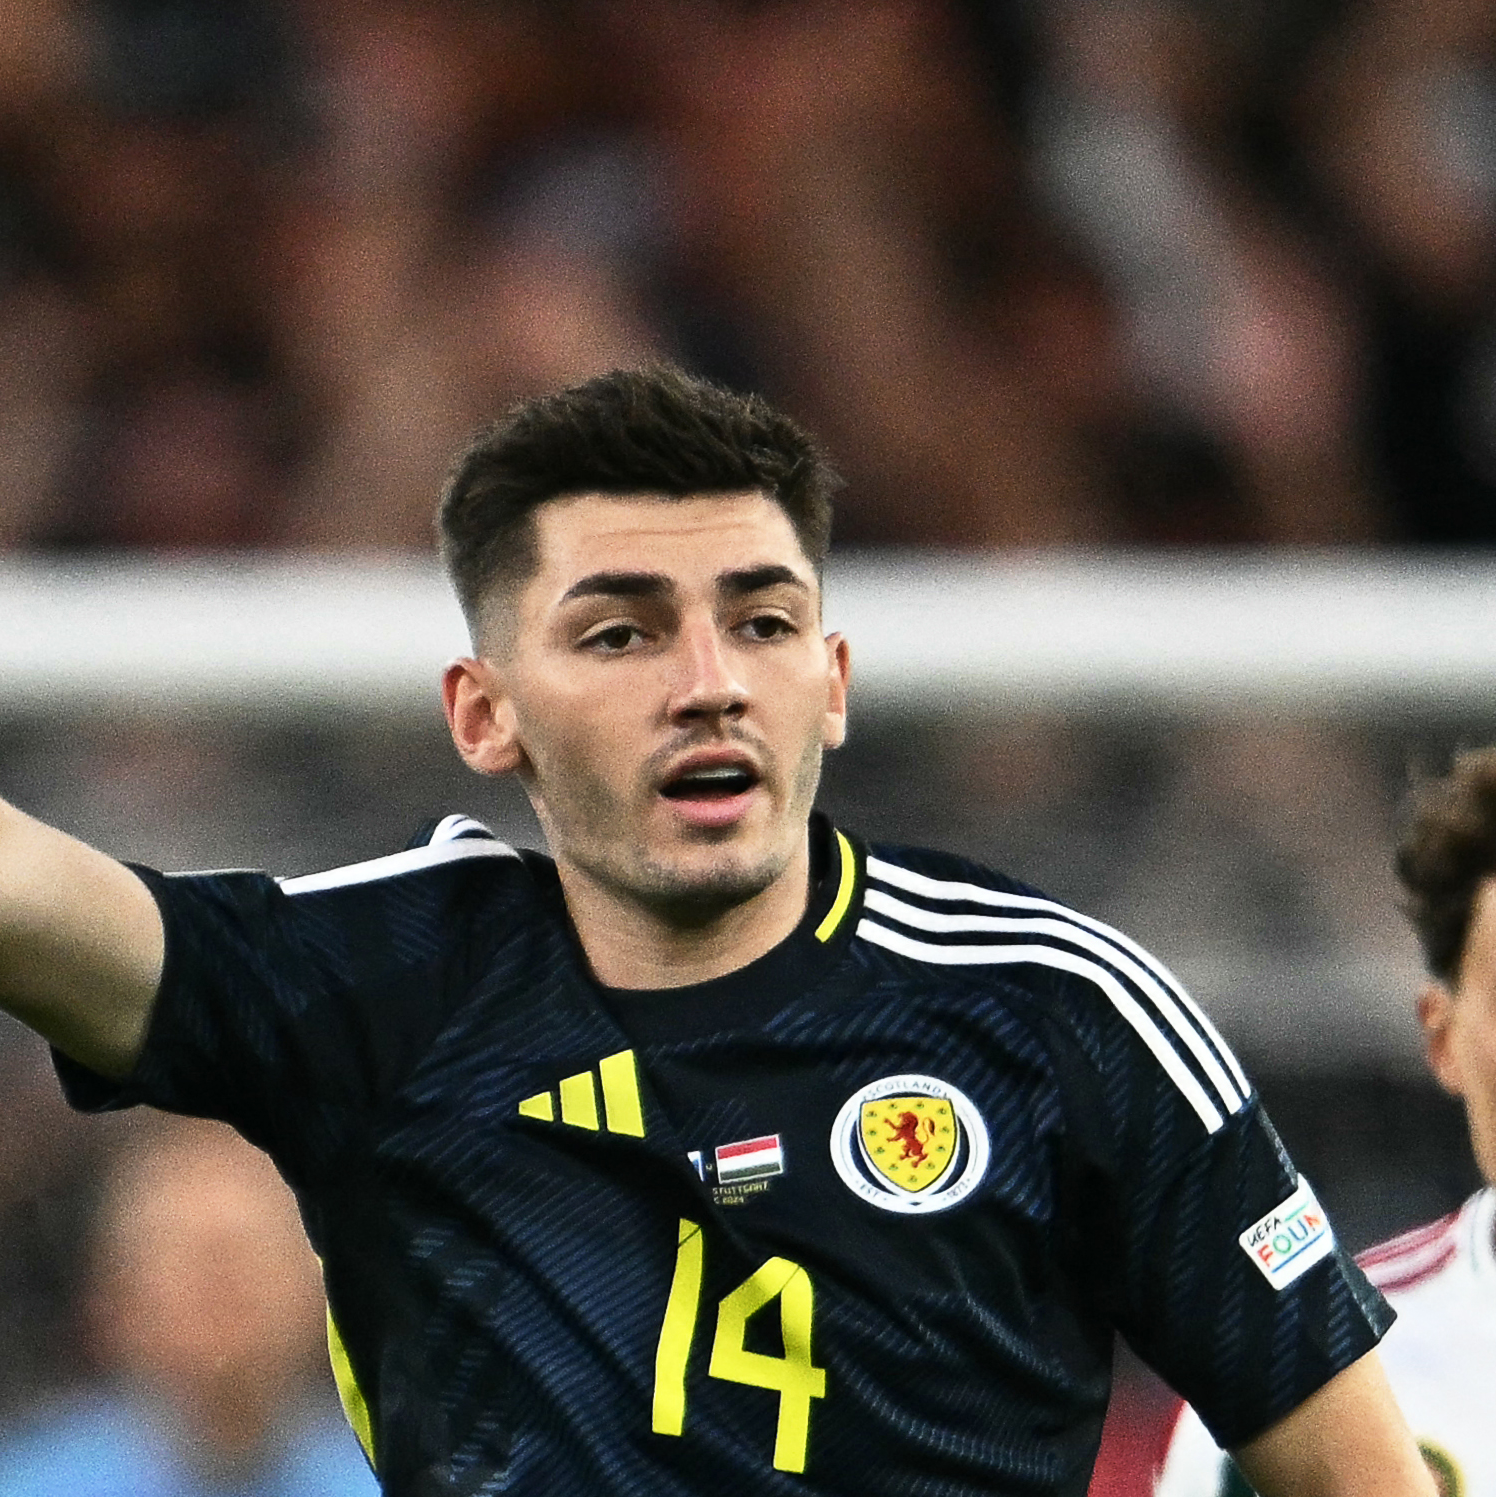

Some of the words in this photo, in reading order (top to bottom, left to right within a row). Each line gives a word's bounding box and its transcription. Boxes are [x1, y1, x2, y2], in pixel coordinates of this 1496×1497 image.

[867, 1080, 942, 1097] SCOTLAND
[1247, 1216, 1282, 1247] UEFA
[652, 1217, 826, 1475] 14
